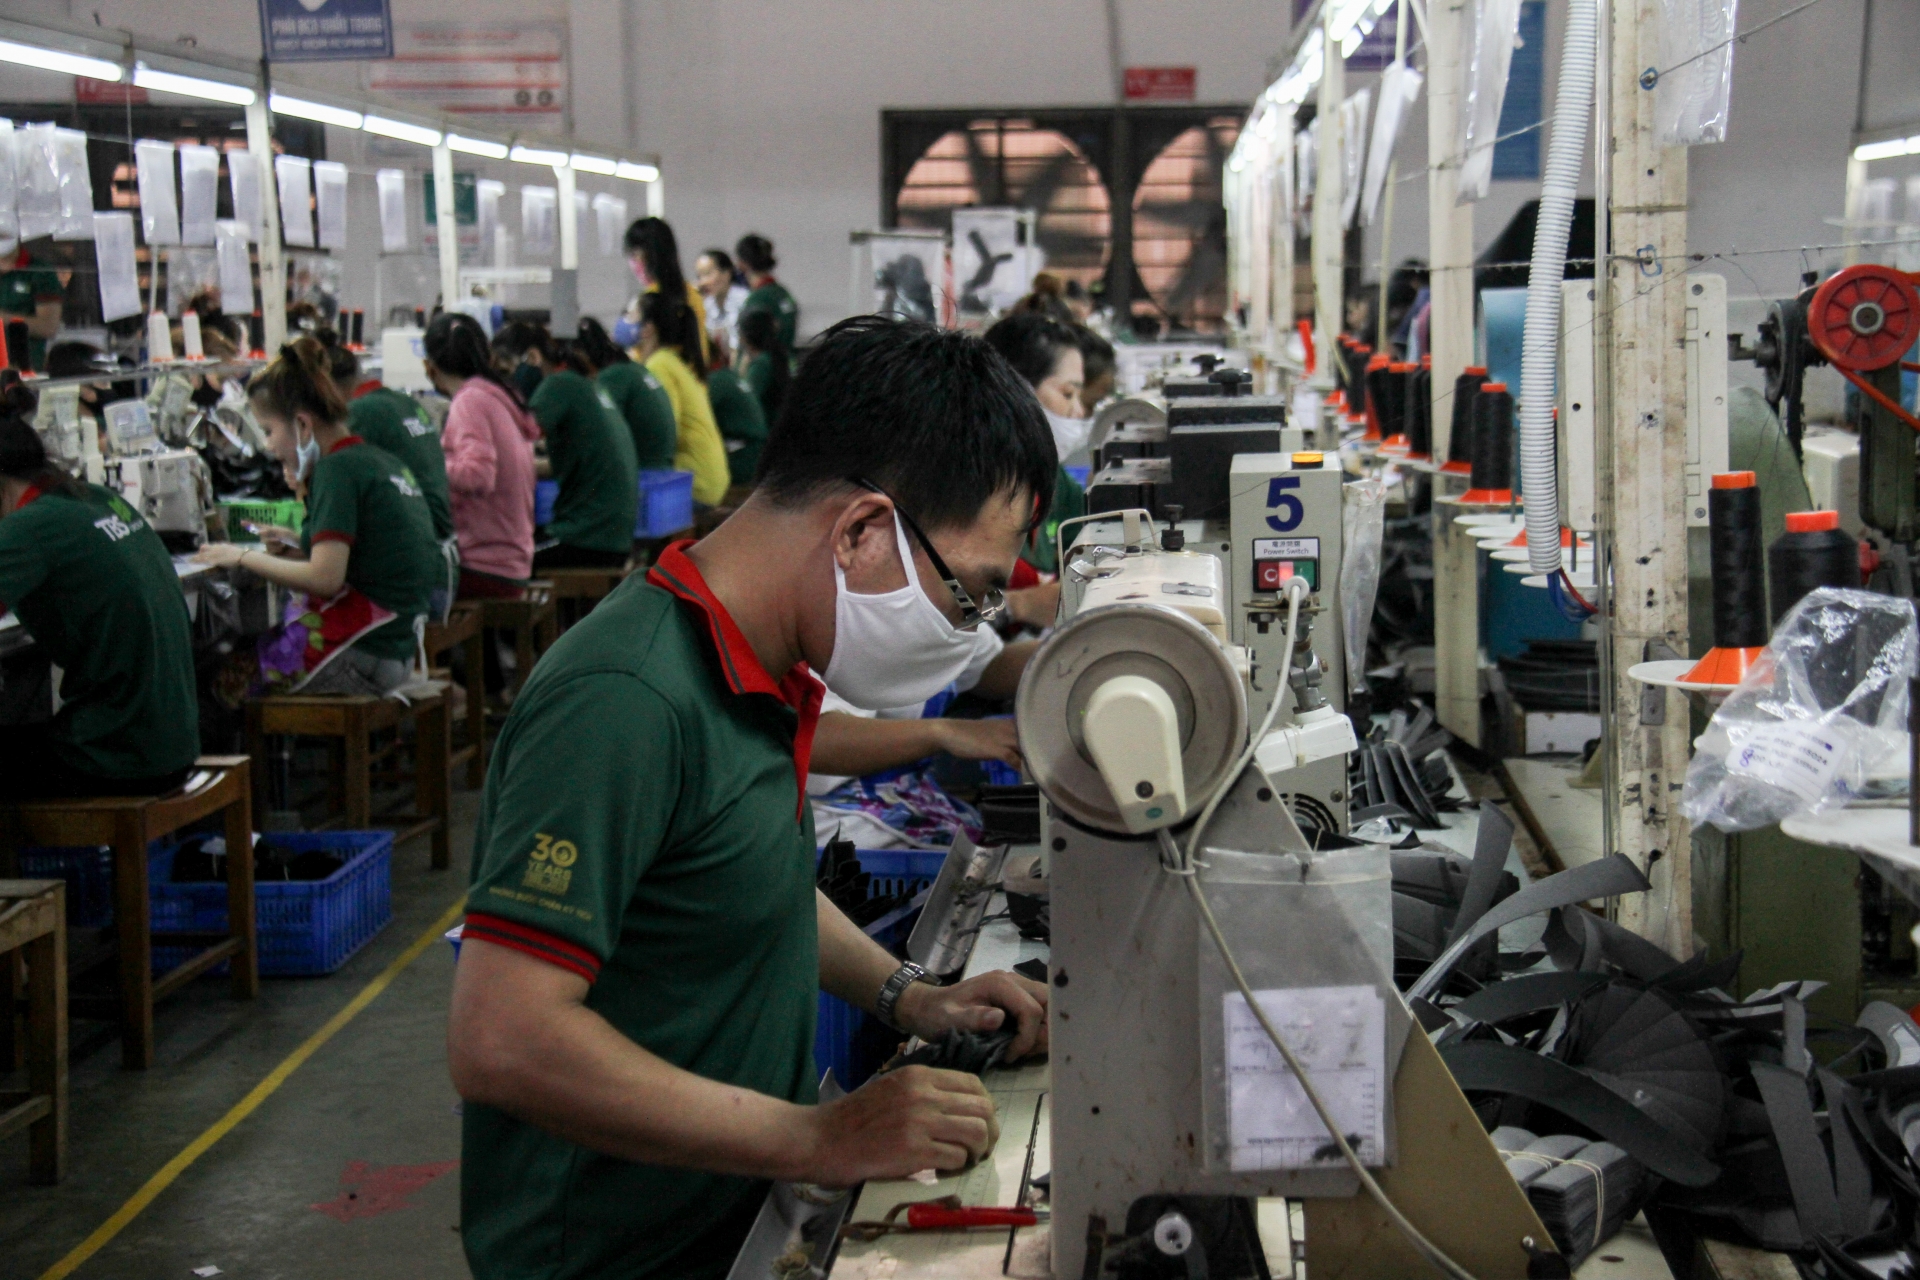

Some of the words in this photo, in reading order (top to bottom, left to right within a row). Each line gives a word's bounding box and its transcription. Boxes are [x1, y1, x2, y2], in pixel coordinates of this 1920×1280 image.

[1265, 476, 1304, 532] 5
[1286, 547, 1309, 555] Switch
[530, 833, 578, 868] 30
[527, 859, 572, 880] YEARS
